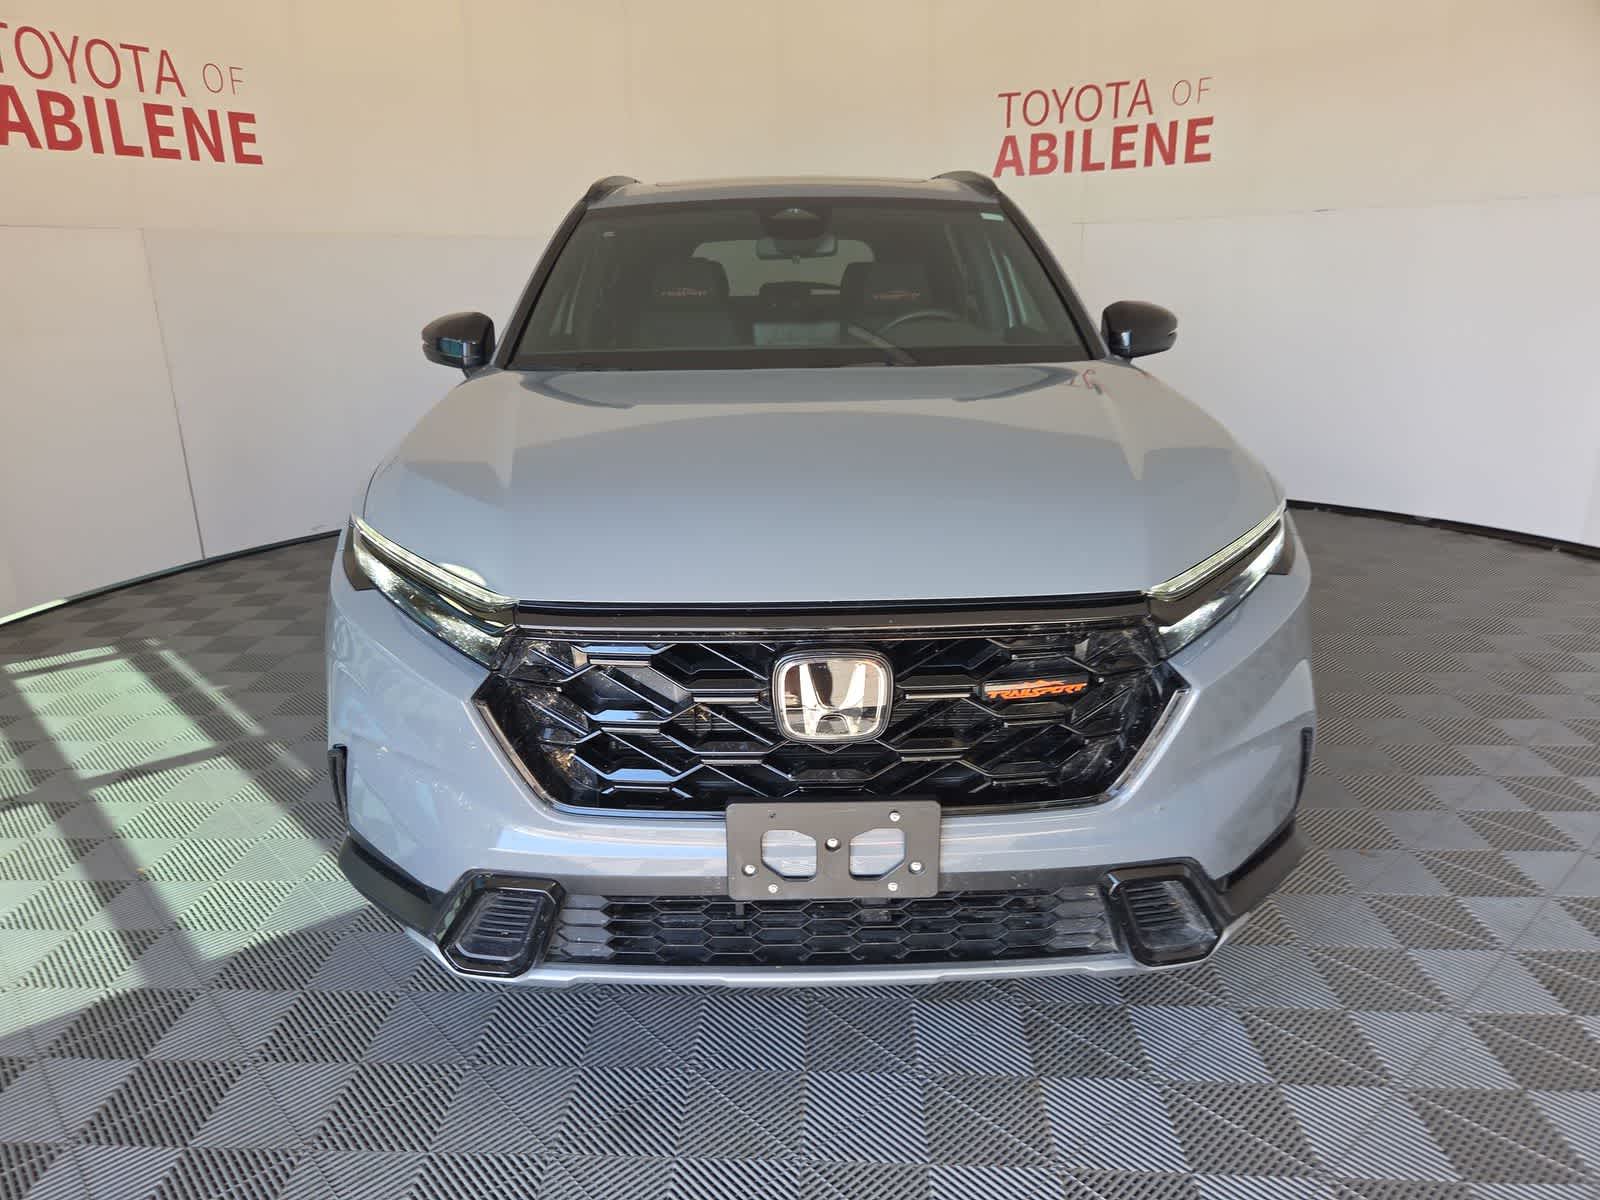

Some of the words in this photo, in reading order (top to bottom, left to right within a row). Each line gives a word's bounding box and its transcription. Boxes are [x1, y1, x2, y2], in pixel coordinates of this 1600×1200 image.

[0, 22, 187, 97] OYOTA
[202, 63, 245, 95] OF
[0, 84, 264, 165] ABILENE
[998, 78, 1154, 129] TOYOTA
[1172, 77, 1213, 106] OF
[993, 116, 1214, 178] ABILENE
